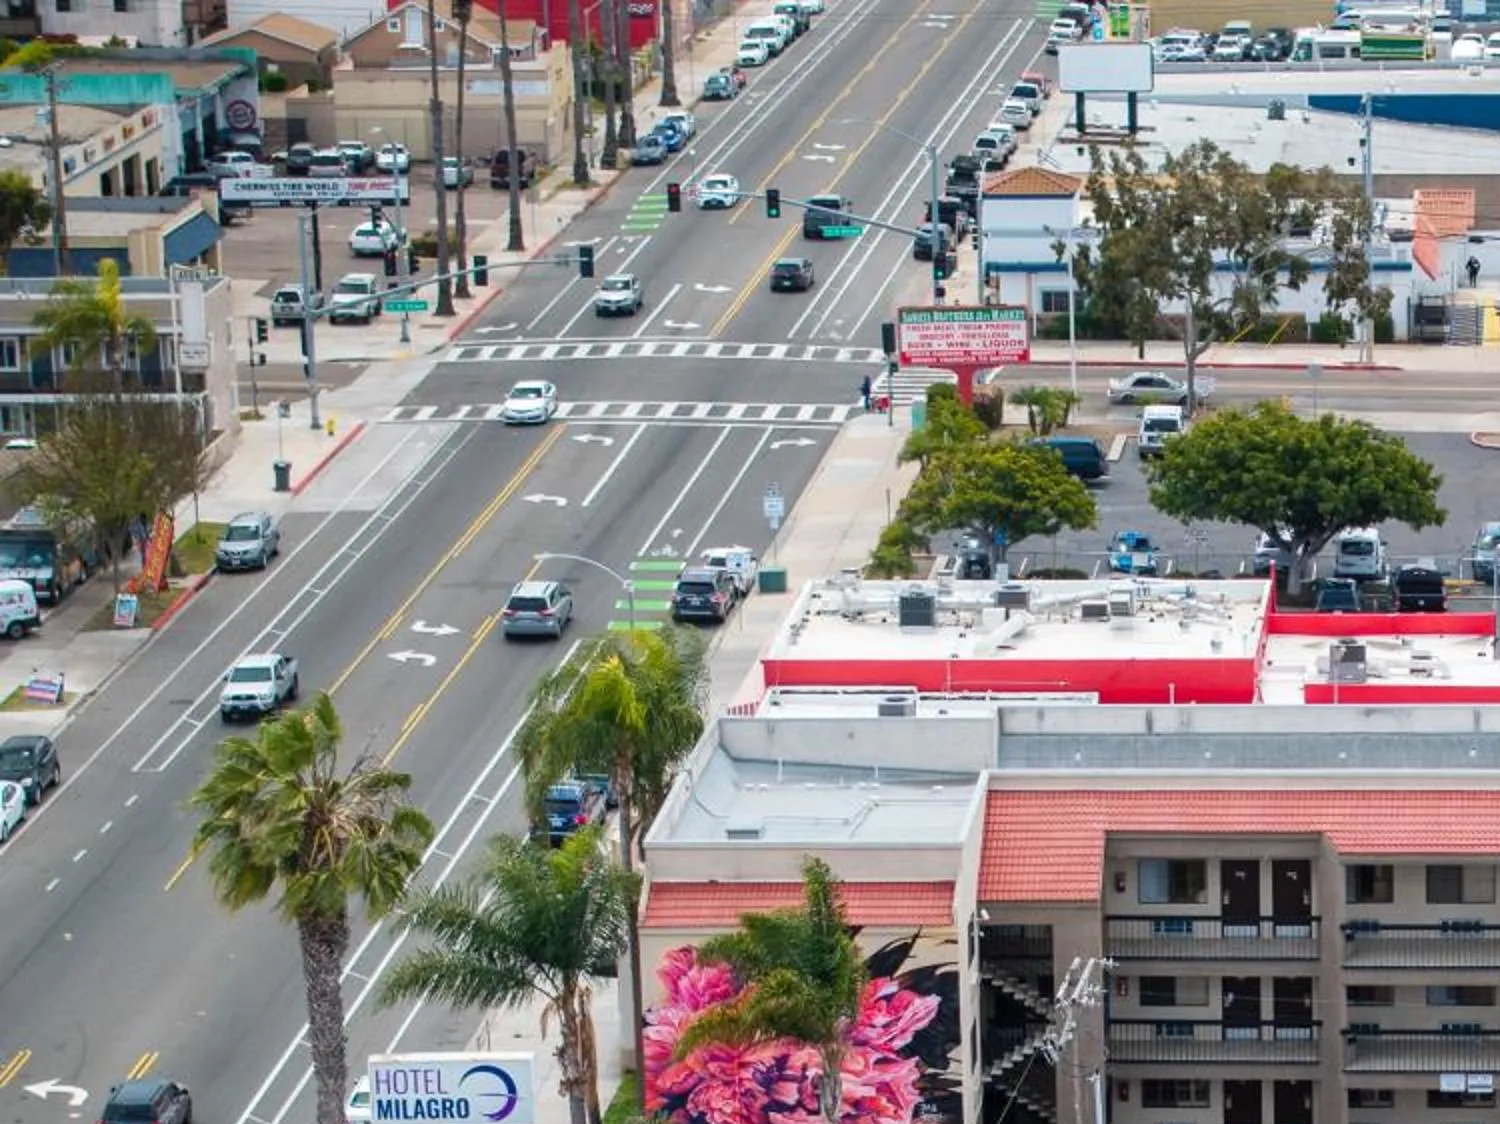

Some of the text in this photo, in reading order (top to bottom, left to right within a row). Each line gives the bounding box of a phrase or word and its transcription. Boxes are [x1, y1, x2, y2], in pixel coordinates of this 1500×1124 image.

[982, 339, 1024, 348] LIQUOR
[375, 1069, 448, 1095] HOTEL
[377, 1098, 470, 1120] MILAGRO
